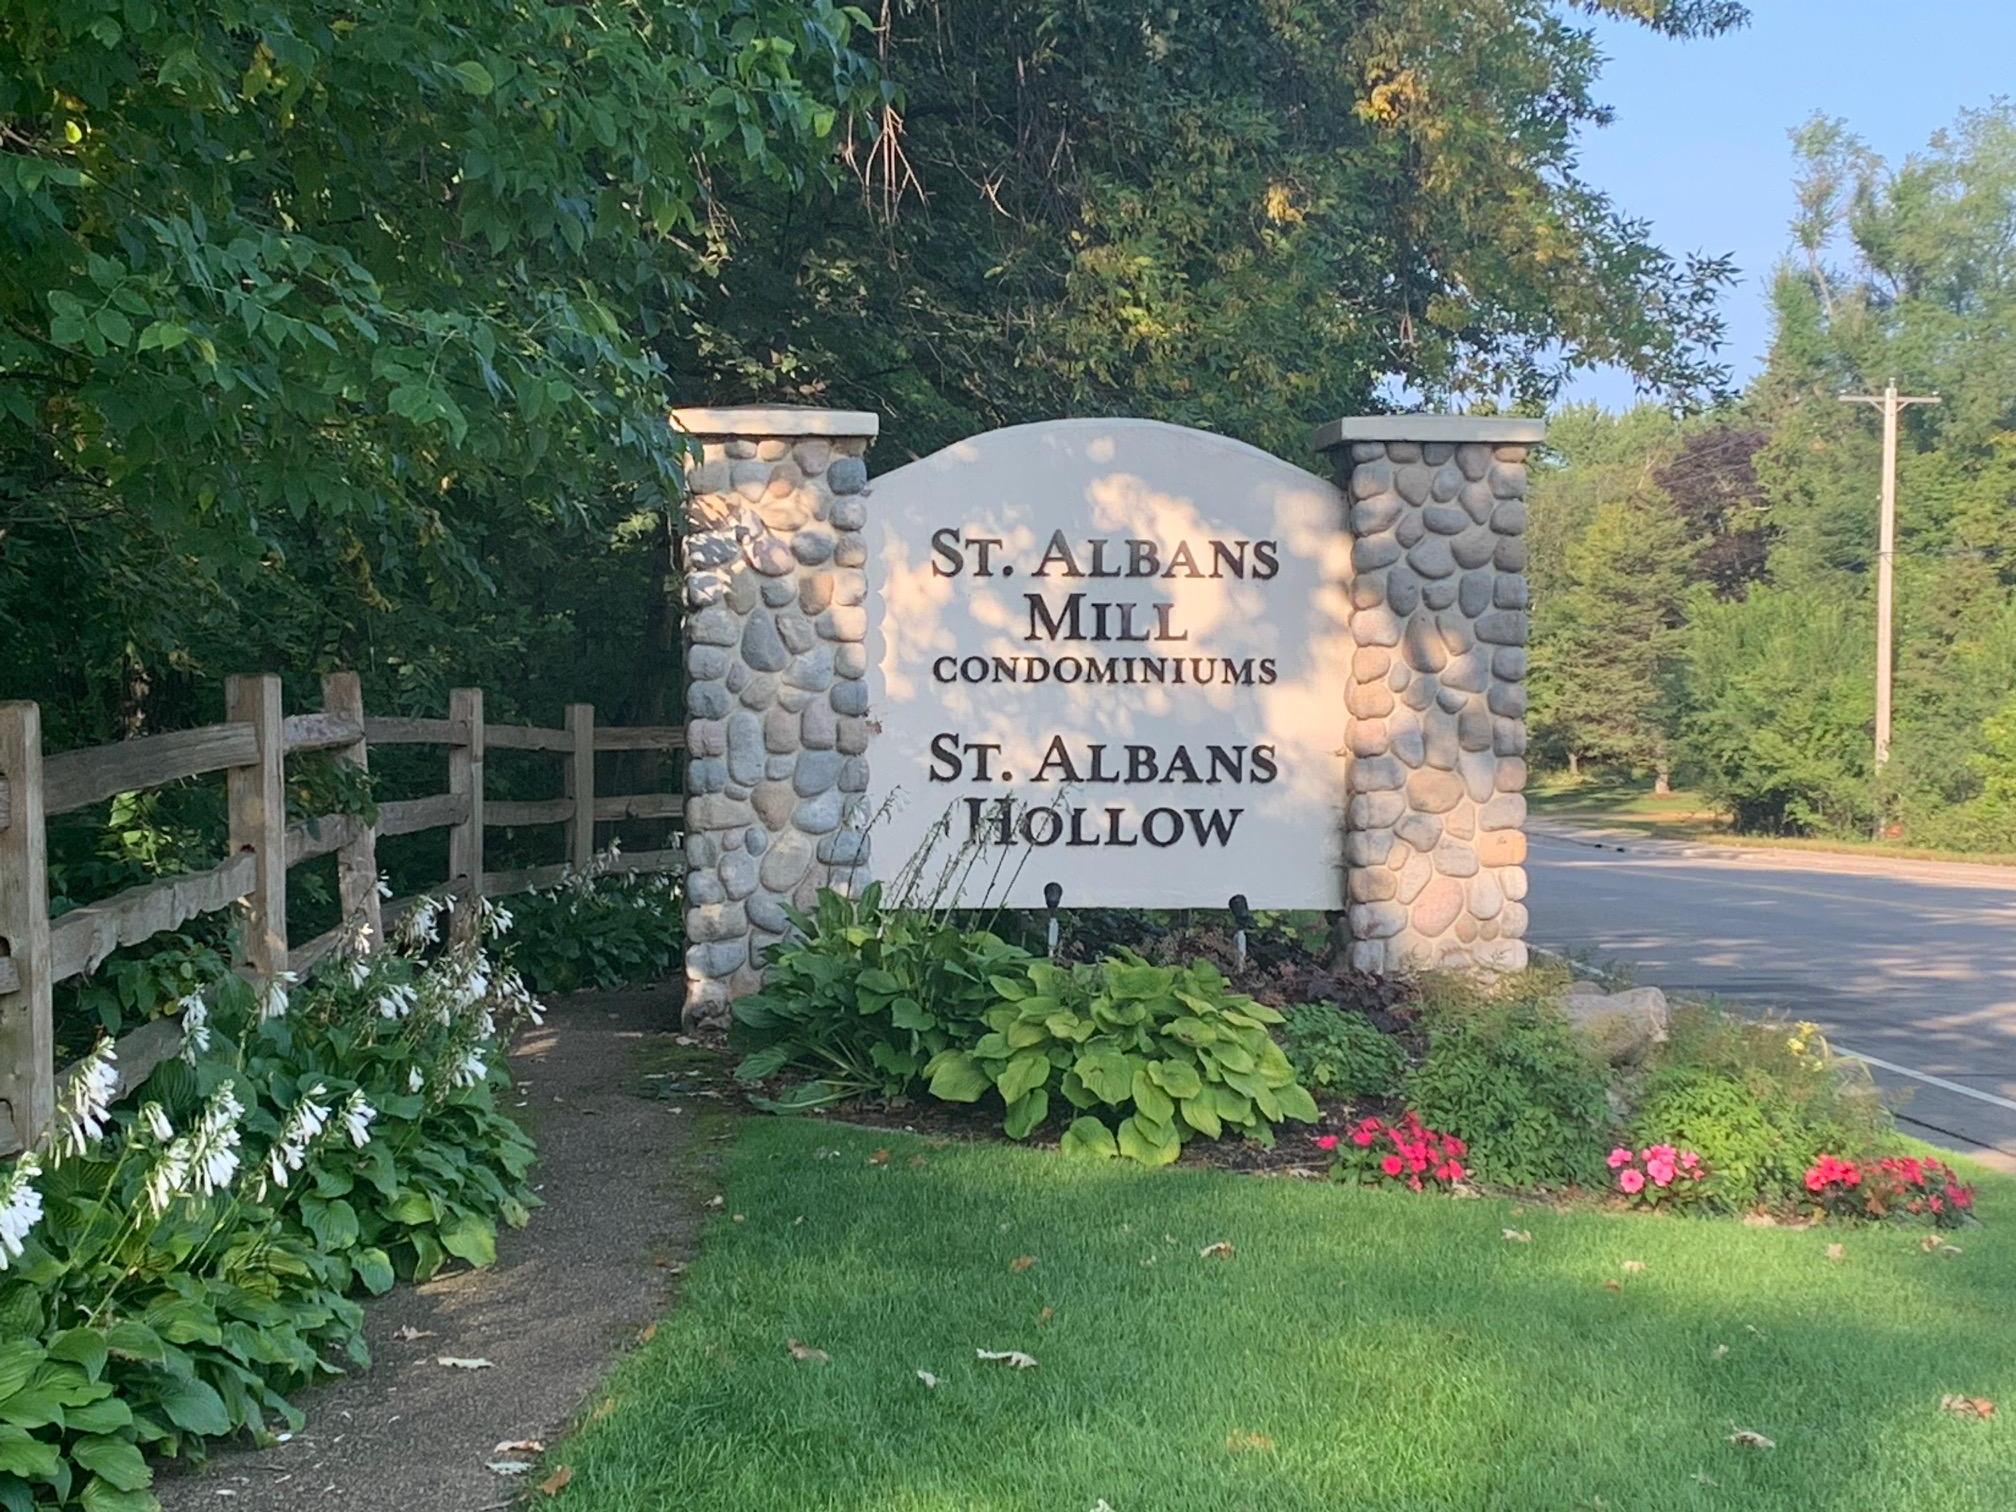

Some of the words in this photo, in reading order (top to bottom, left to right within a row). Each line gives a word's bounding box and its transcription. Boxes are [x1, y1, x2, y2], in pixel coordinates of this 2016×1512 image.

[931, 527, 1014, 578] ST.
[1030, 528, 1280, 580] ALBANS
[1022, 592, 1188, 642] MILL
[932, 655, 1278, 688] CONDOMINIUMS
[928, 732, 1013, 783] ST.
[1028, 734, 1278, 785] ALBANS
[963, 797, 1245, 848] HOLLOW
